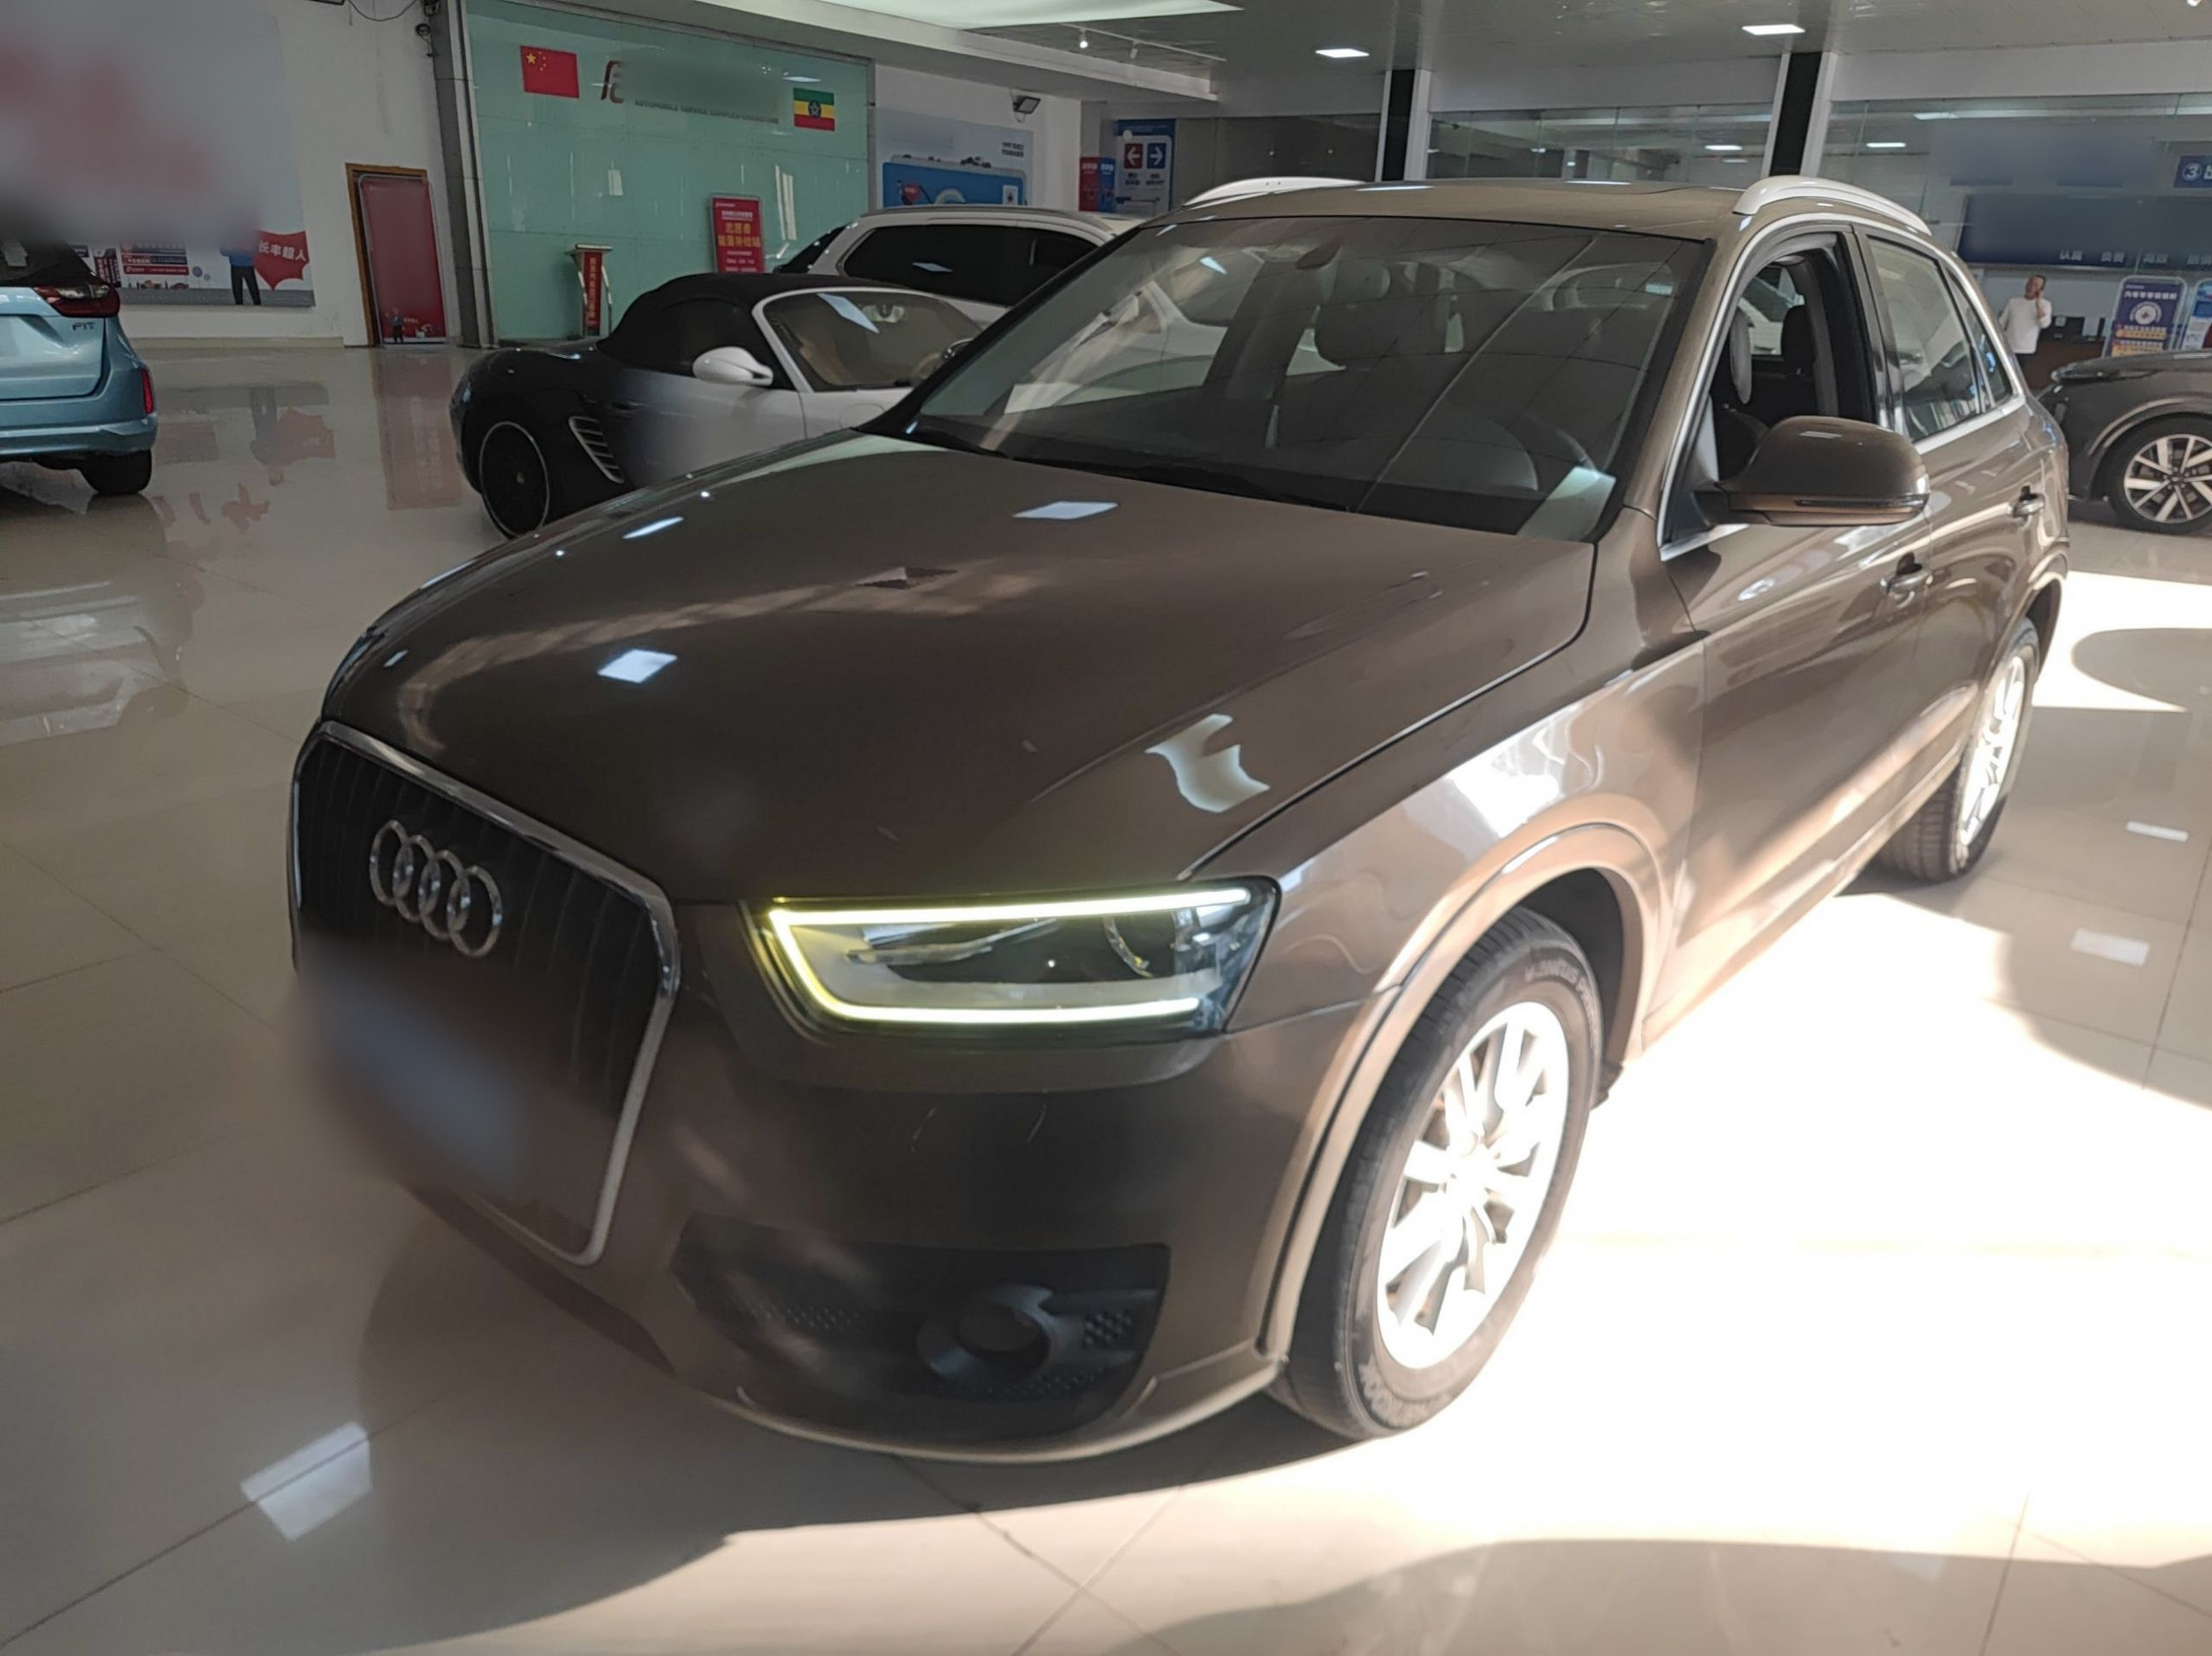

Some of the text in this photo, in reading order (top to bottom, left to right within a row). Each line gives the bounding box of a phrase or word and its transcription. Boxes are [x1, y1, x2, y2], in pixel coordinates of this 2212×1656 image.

[634, 100, 679, 111] AUTOMOBILE
[681, 105, 707, 115] SERVICE
[72, 322, 96, 331] FIT
